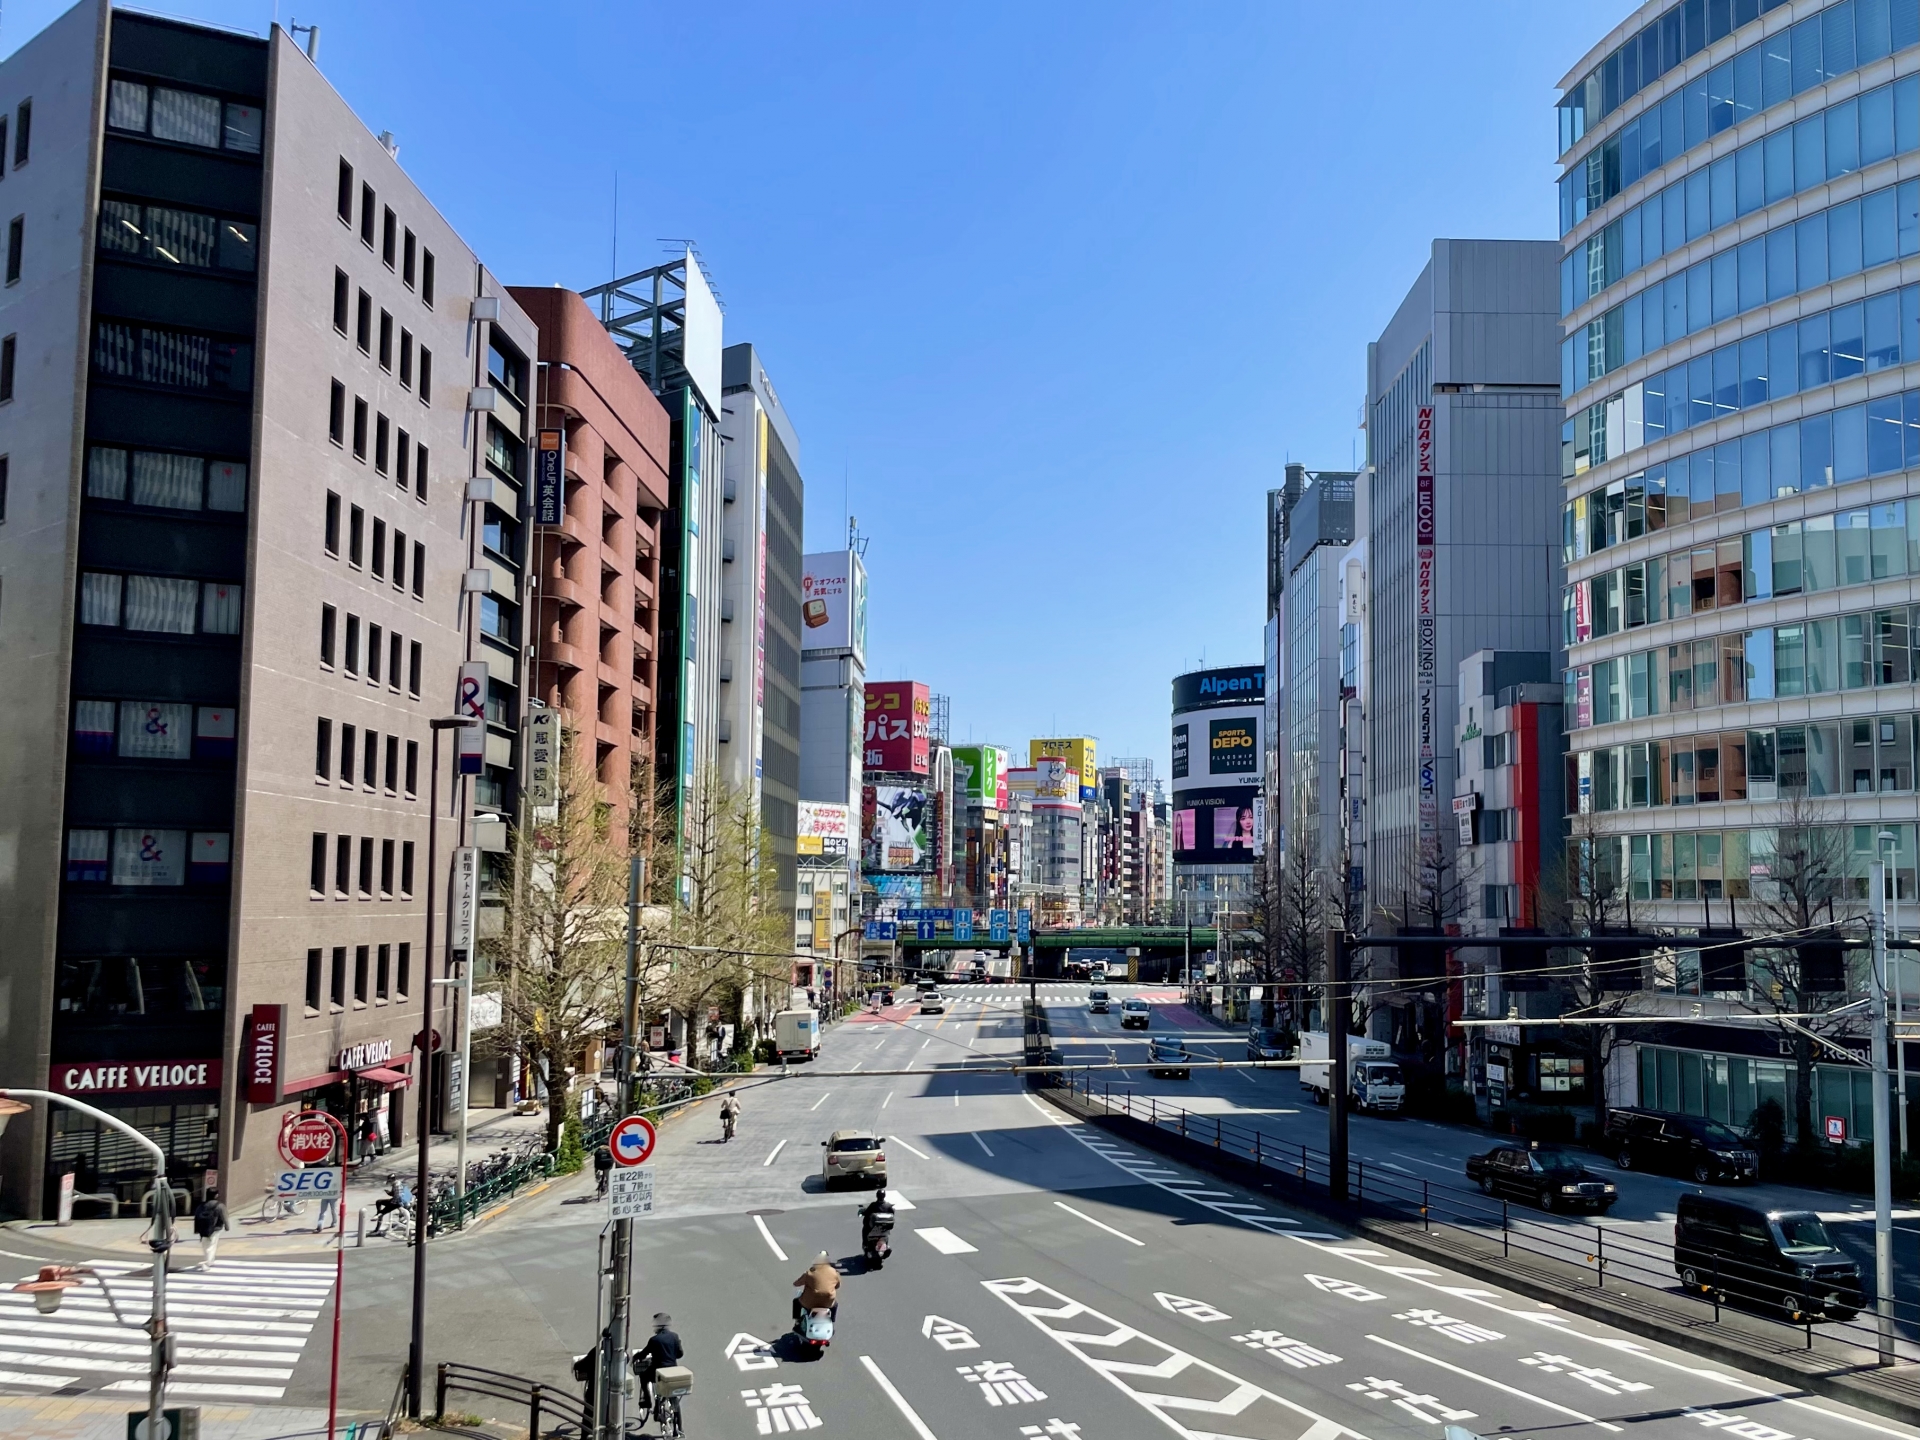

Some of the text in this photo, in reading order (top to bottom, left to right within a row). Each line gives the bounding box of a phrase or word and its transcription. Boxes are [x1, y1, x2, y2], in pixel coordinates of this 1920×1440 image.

[1418, 408, 1432, 472] NOAダンス
[542, 485, 555, 522] 英会話
[1419, 491, 1432, 533] ECC
[1419, 561, 1431, 614] NOAダンス
[1423, 619, 1433, 670] BOXING
[1200, 677, 1251, 695] Alpen
[1041, 741, 1073, 749] プロミス
[1212, 736, 1253, 749] DEPO
[819, 808, 841, 818] カラオケ
[462, 852, 472, 945] 新宿アトムクリニック
[254, 1034, 274, 1084] VELOCE
[365, 1039, 392, 1065] VELOCE
[134, 1064, 208, 1087] VELOCE
[291, 1132, 331, 1150] 消火栓
[277, 1171, 333, 1191] SEG
[613, 1192, 652, 1204] 環七通り以内
[613, 1202, 652, 1215] 都心全域
